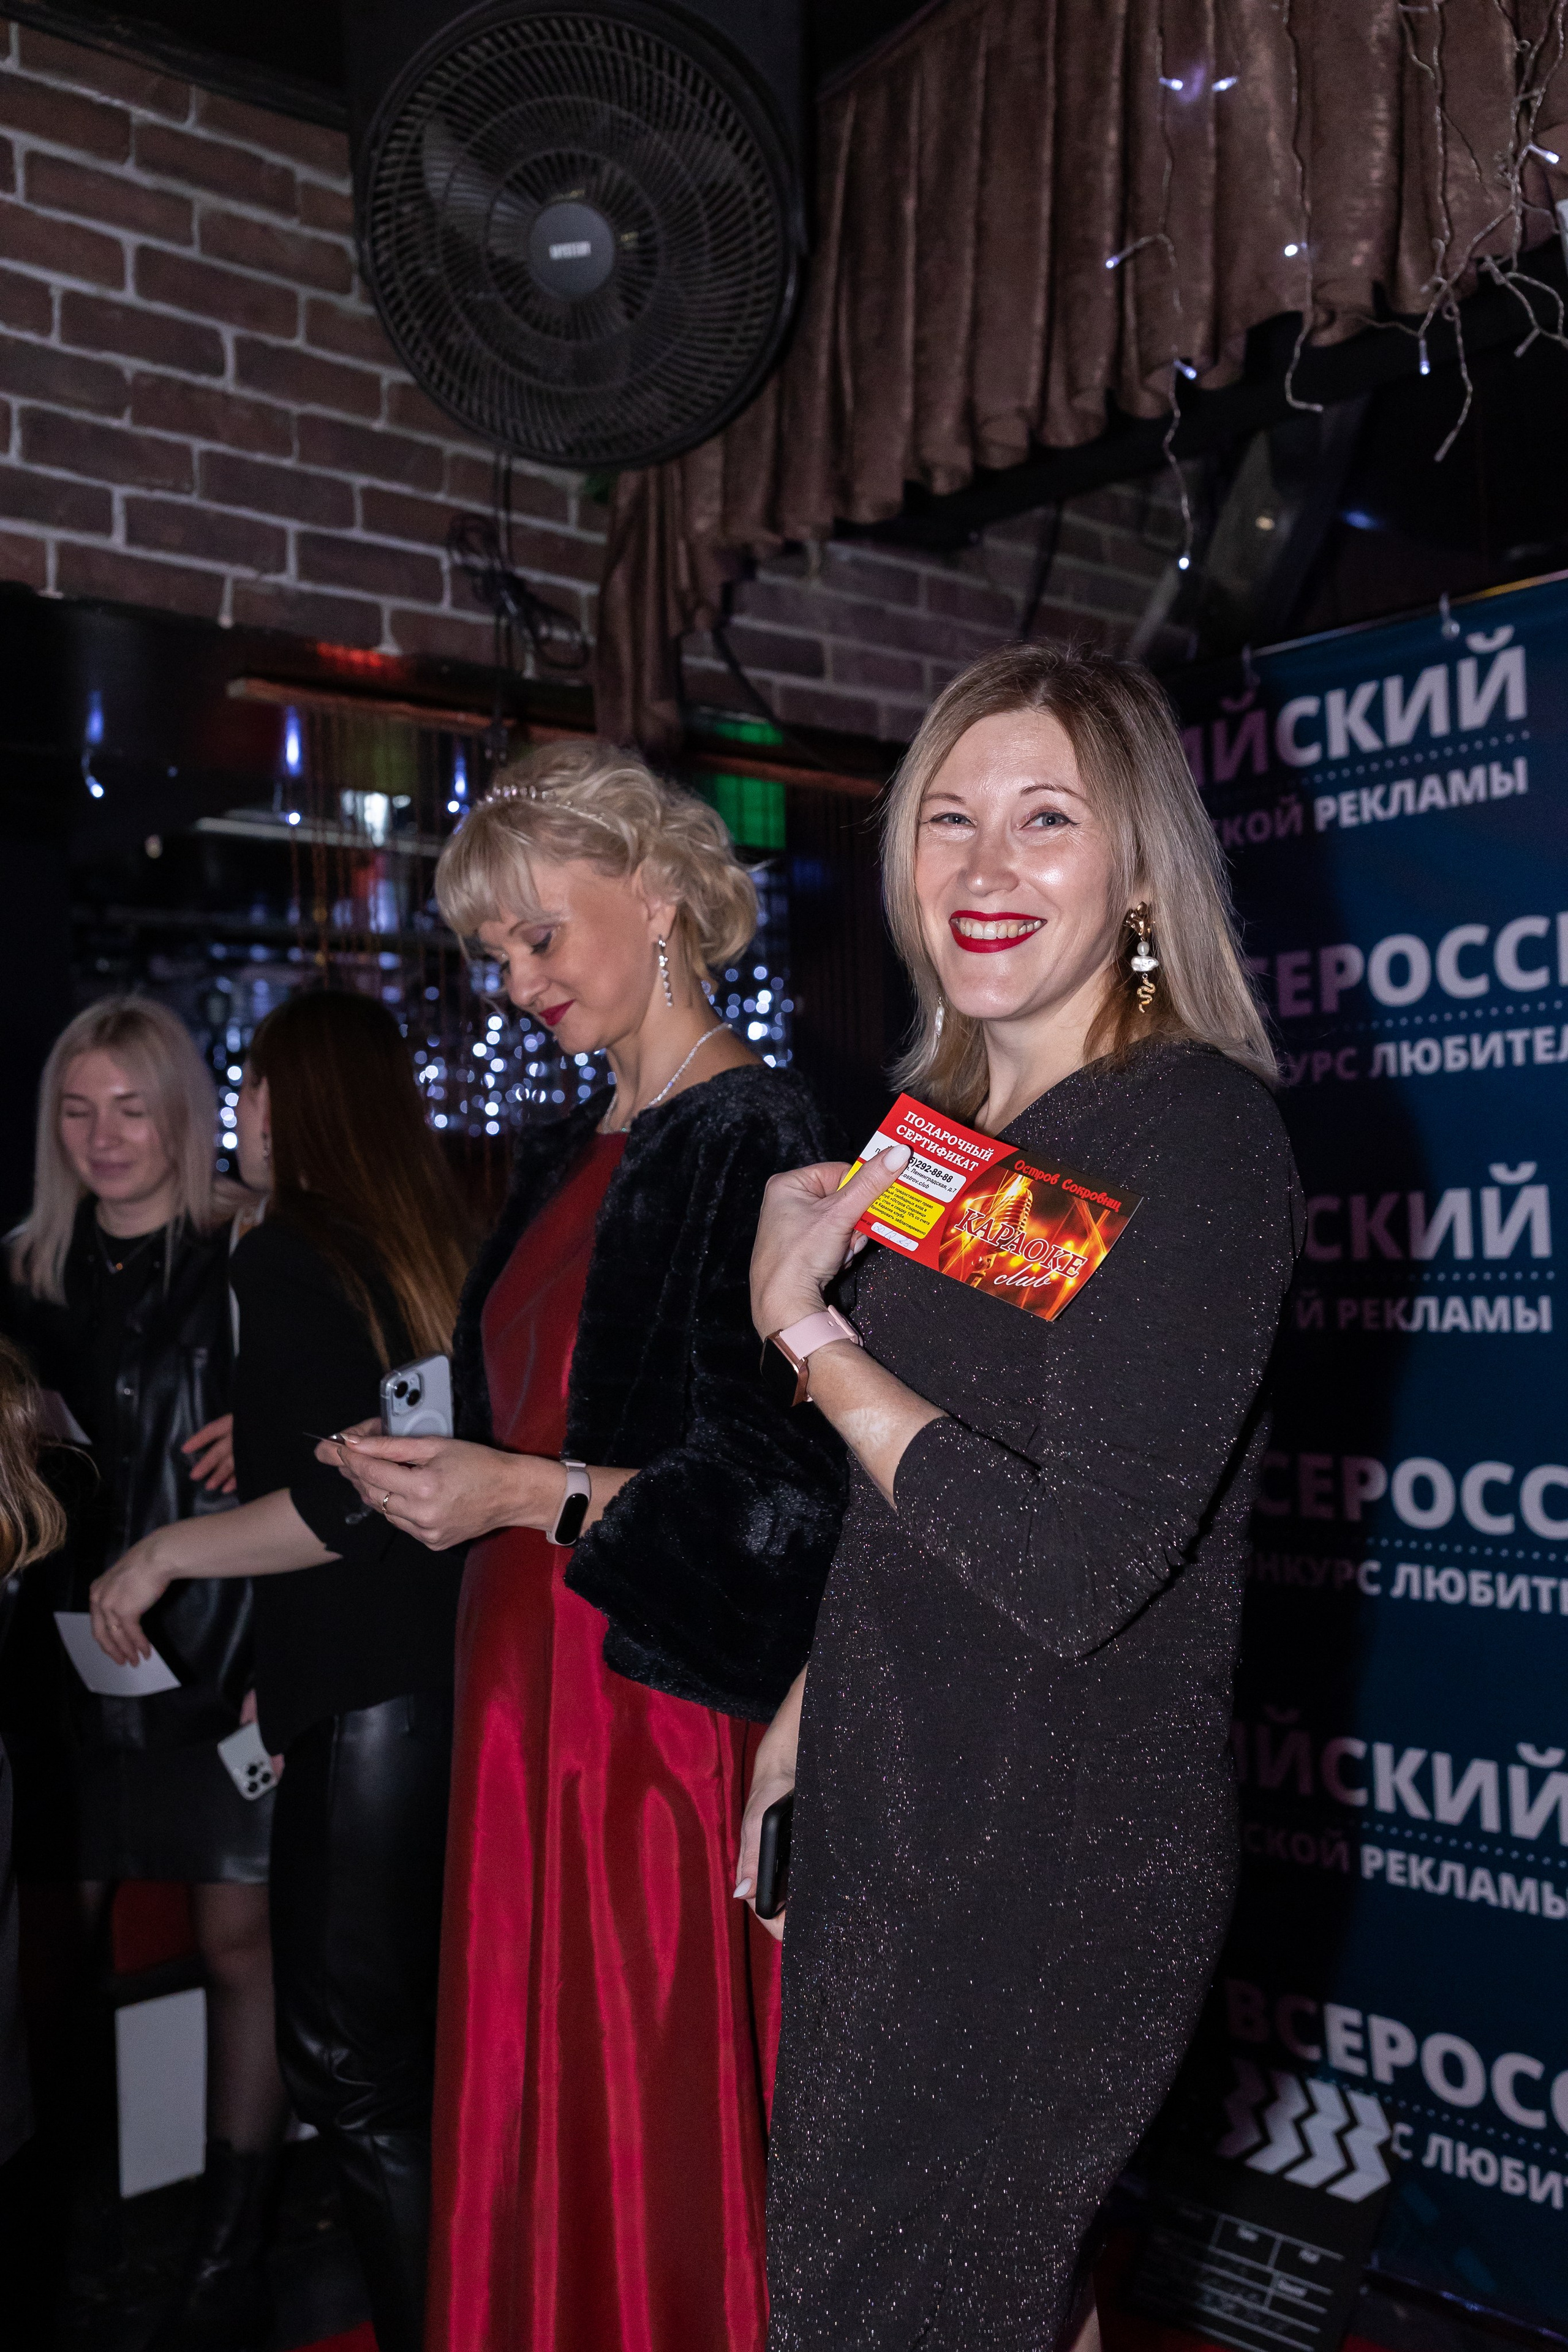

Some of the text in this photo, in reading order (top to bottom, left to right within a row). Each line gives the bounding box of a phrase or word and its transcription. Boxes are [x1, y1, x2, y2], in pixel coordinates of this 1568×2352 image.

[1212, 756, 1528, 850] КОЙ РЕКЛАМЫ
[1251, 910, 1568, 1018] ЕРОСС
[896, 1125, 979, 1172] СЕРТИФИКАТ
[903, 1111, 995, 1162] ПОДАРОЧНЫЙ
[895, 1188, 922, 1204] предоставляет
[901, 1172, 930, 1189] .ostrov.club
[911, 1168, 947, 1190] Ленинградская,
[1014, 1159, 1121, 1213] Остров Сокровищ
[878, 1202, 894, 1213] Караоке
[895, 1218, 926, 1235] заблаговременно
[1305, 1161, 1553, 1262] СКИЙ
[954, 1207, 1088, 1280] КАРАОКЕ
[993, 1263, 1061, 1288] club
[1336, 1294, 1553, 1334] РЕКЛАМЫ
[1422, 2132, 1568, 2211] ЛЮБИ
